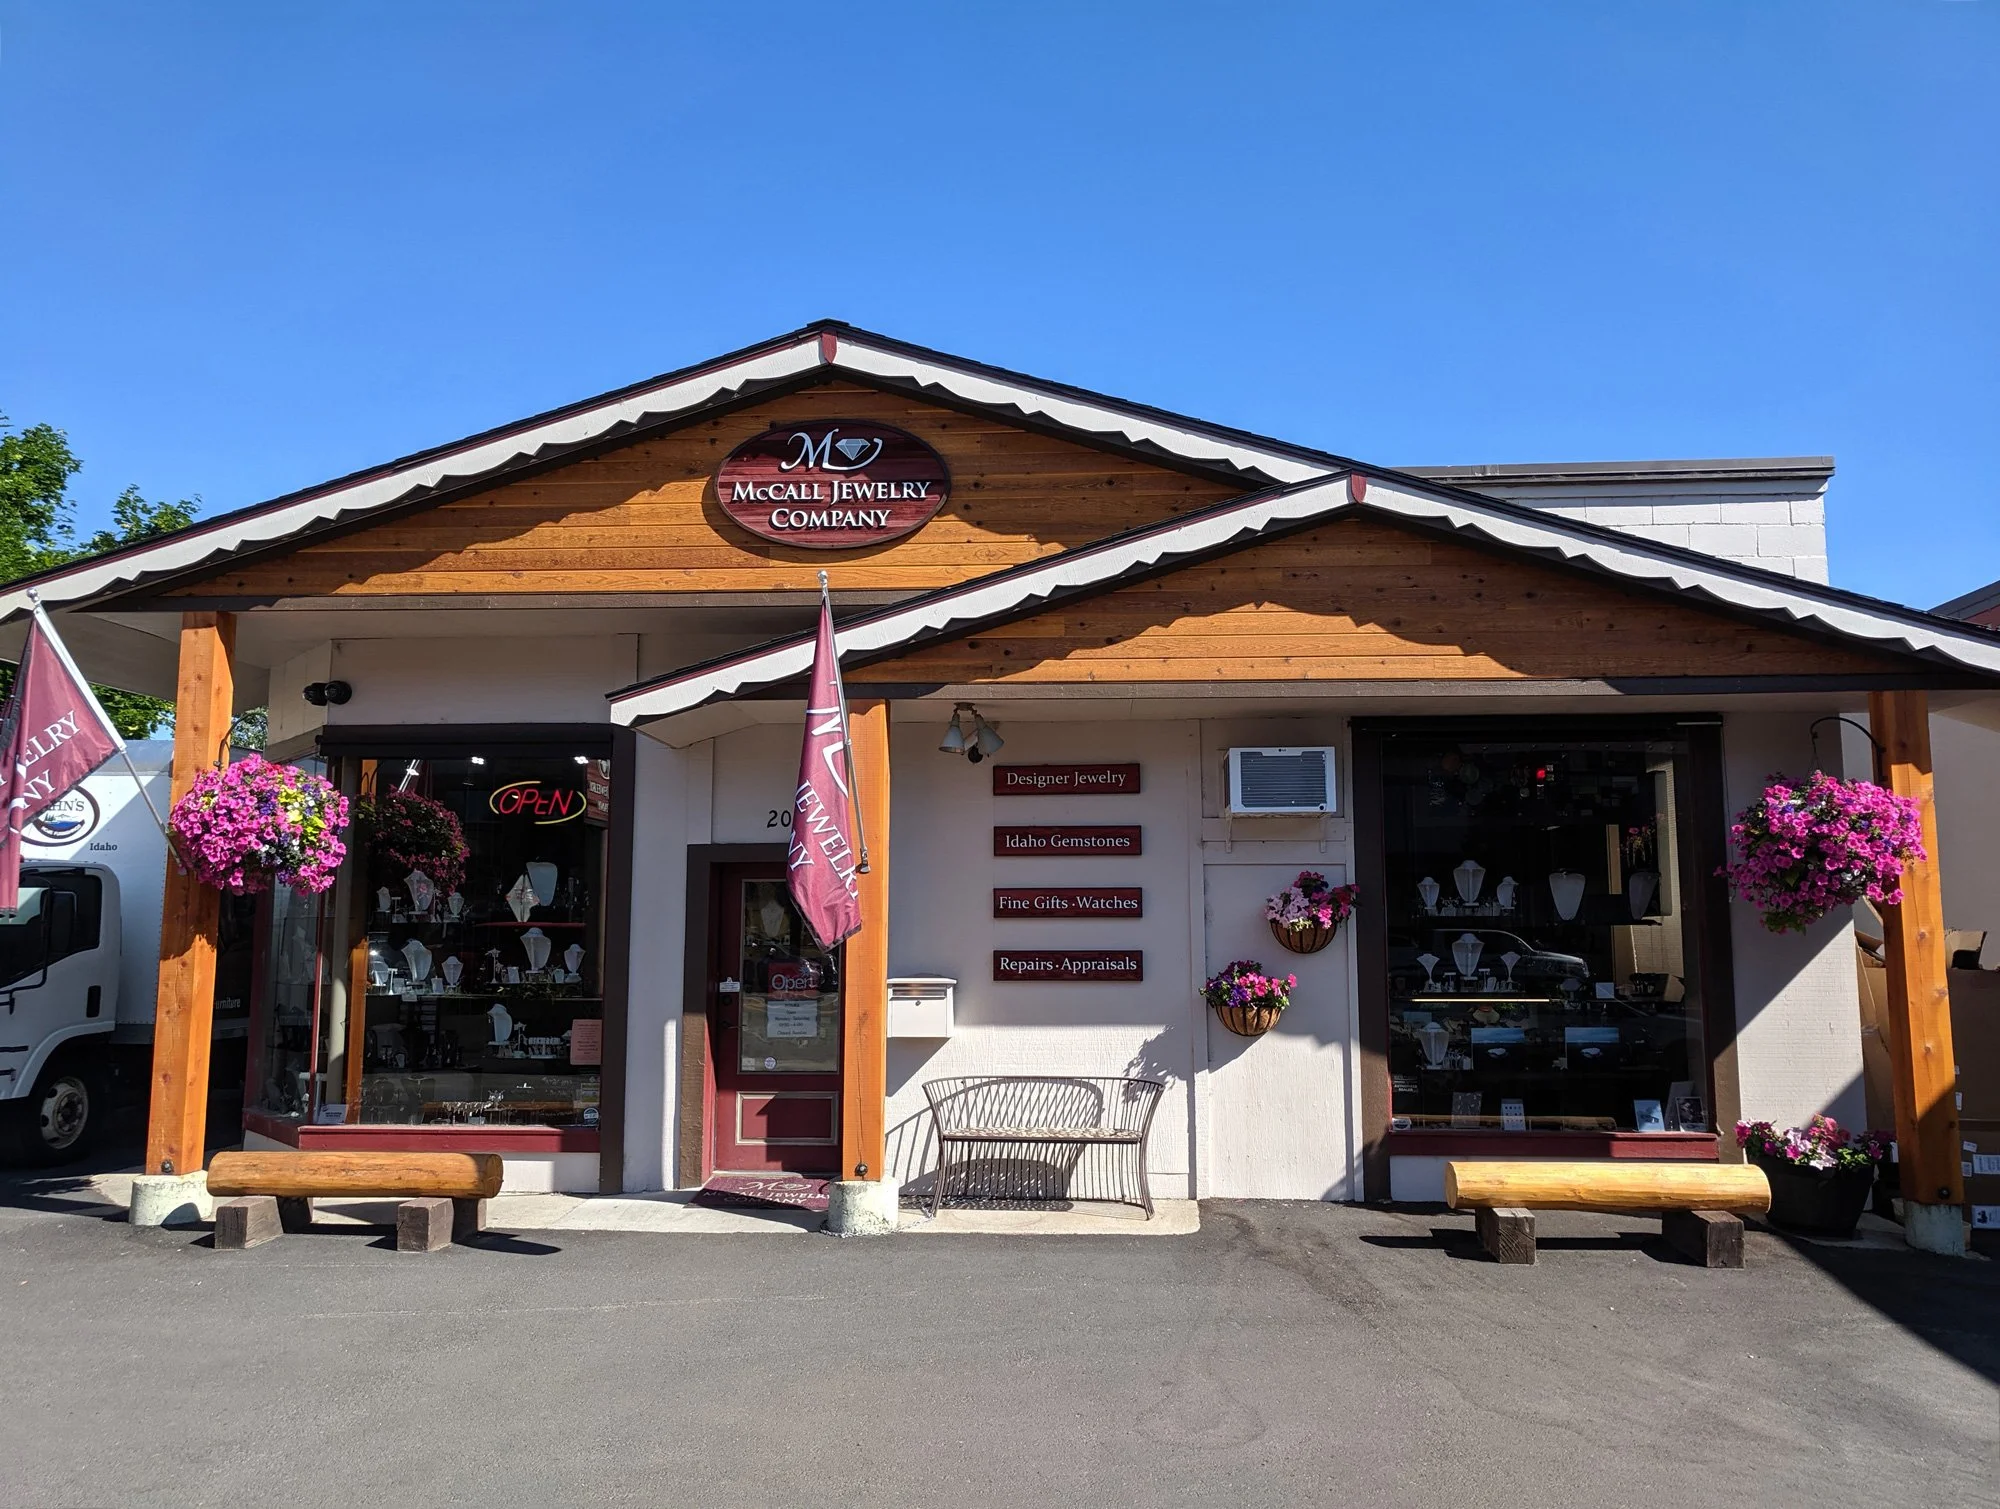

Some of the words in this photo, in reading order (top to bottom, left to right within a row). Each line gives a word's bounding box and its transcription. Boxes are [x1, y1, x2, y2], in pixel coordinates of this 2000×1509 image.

[831, 480, 931, 505] JEWELRY
[771, 508, 891, 528] COMPANY
[25, 710, 80, 767] ELRY
[1006, 772, 1070, 788] Designer
[1074, 771, 1126, 787] Jewelry
[49, 798, 85, 811] HN'S
[499, 788, 574, 815] OPEN
[90, 843, 118, 851] Idaho
[1006, 834, 1047, 848] Idaho
[1051, 834, 1131, 848] Gemstones
[999, 896, 1030, 909] Fine
[1034, 895, 1068, 909] Gifts
[1075, 895, 1138, 909] Watches
[1000, 957, 1053, 974] Repairs
[1061, 957, 1137, 974] Appraisals
